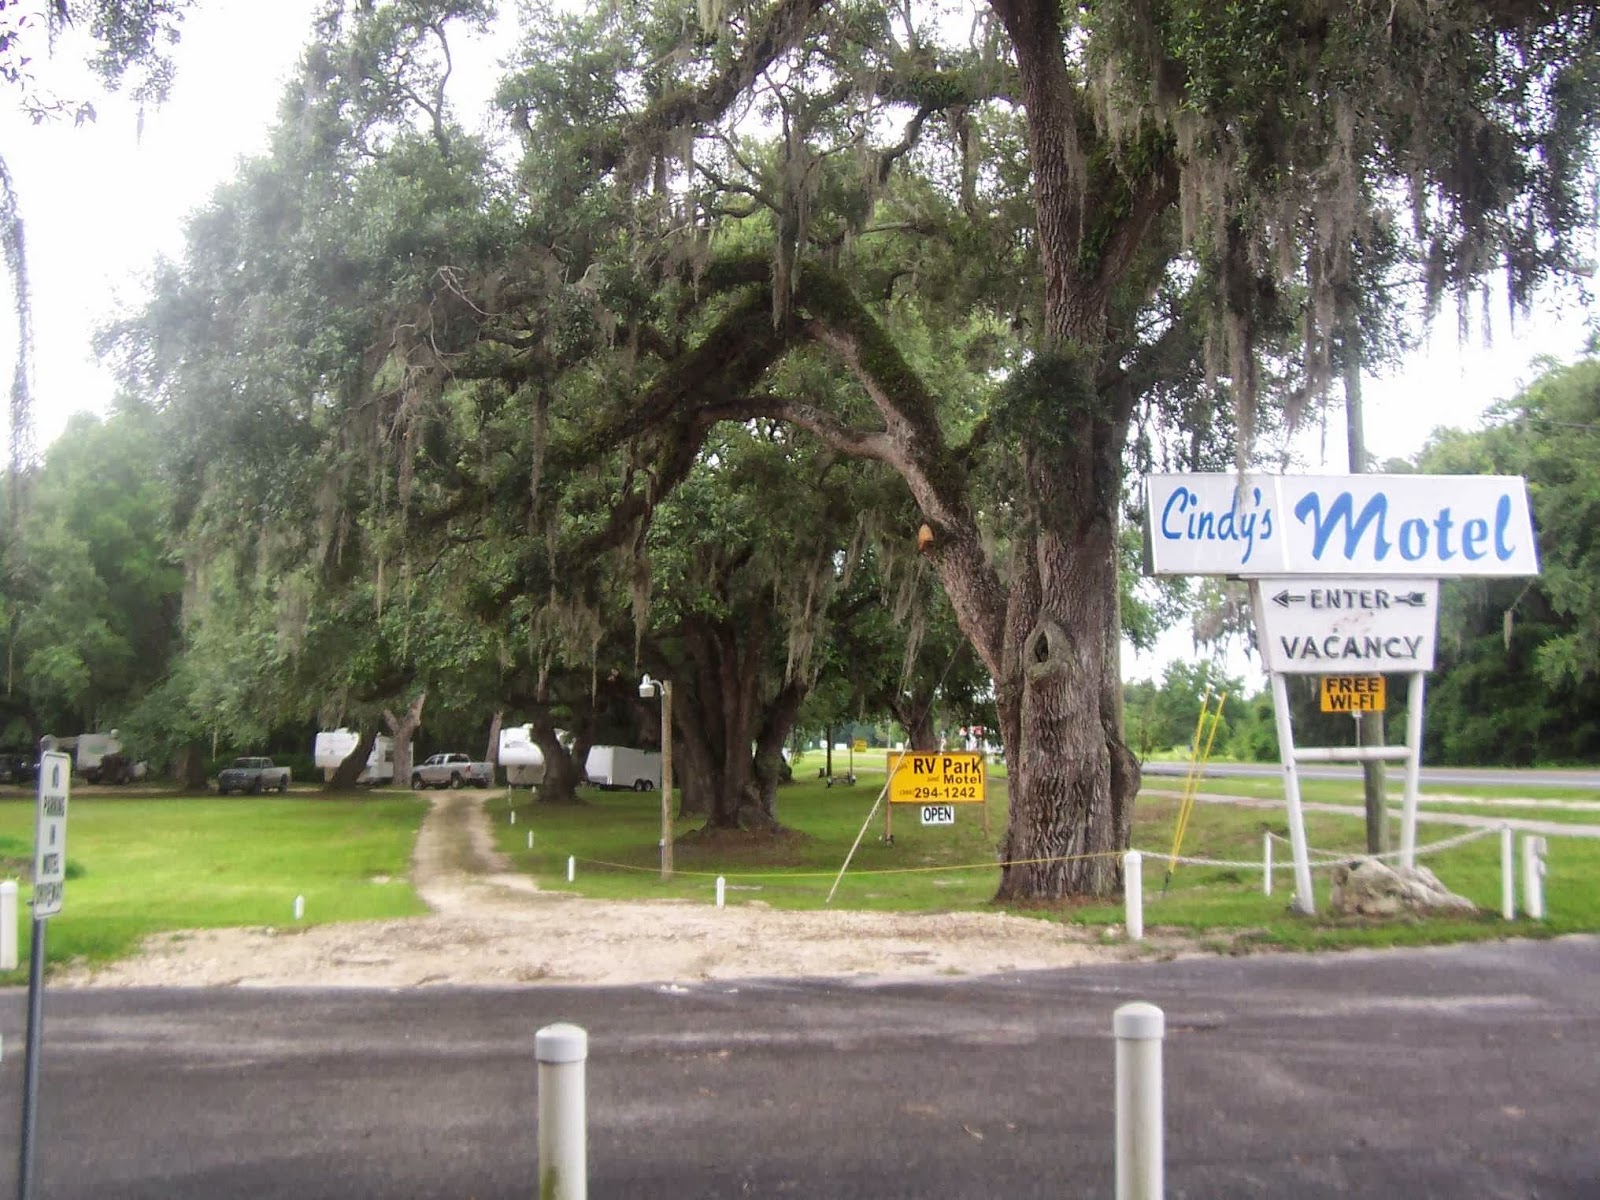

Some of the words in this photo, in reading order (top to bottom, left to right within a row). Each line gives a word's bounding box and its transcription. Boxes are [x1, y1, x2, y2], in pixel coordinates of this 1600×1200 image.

[1162, 486, 1272, 564] Cindy's
[1294, 491, 1515, 562] Motel
[1310, 589, 1390, 609] ENTER
[1281, 635, 1423, 659] VACANCY
[1326, 678, 1380, 693] FREE
[1330, 694, 1375, 709] WI-FI
[914, 758, 936, 774] RV
[943, 758, 981, 774] Park
[943, 774, 982, 785] Motel
[914, 787, 976, 798] 294-1242
[923, 807, 952, 821] OPEN
